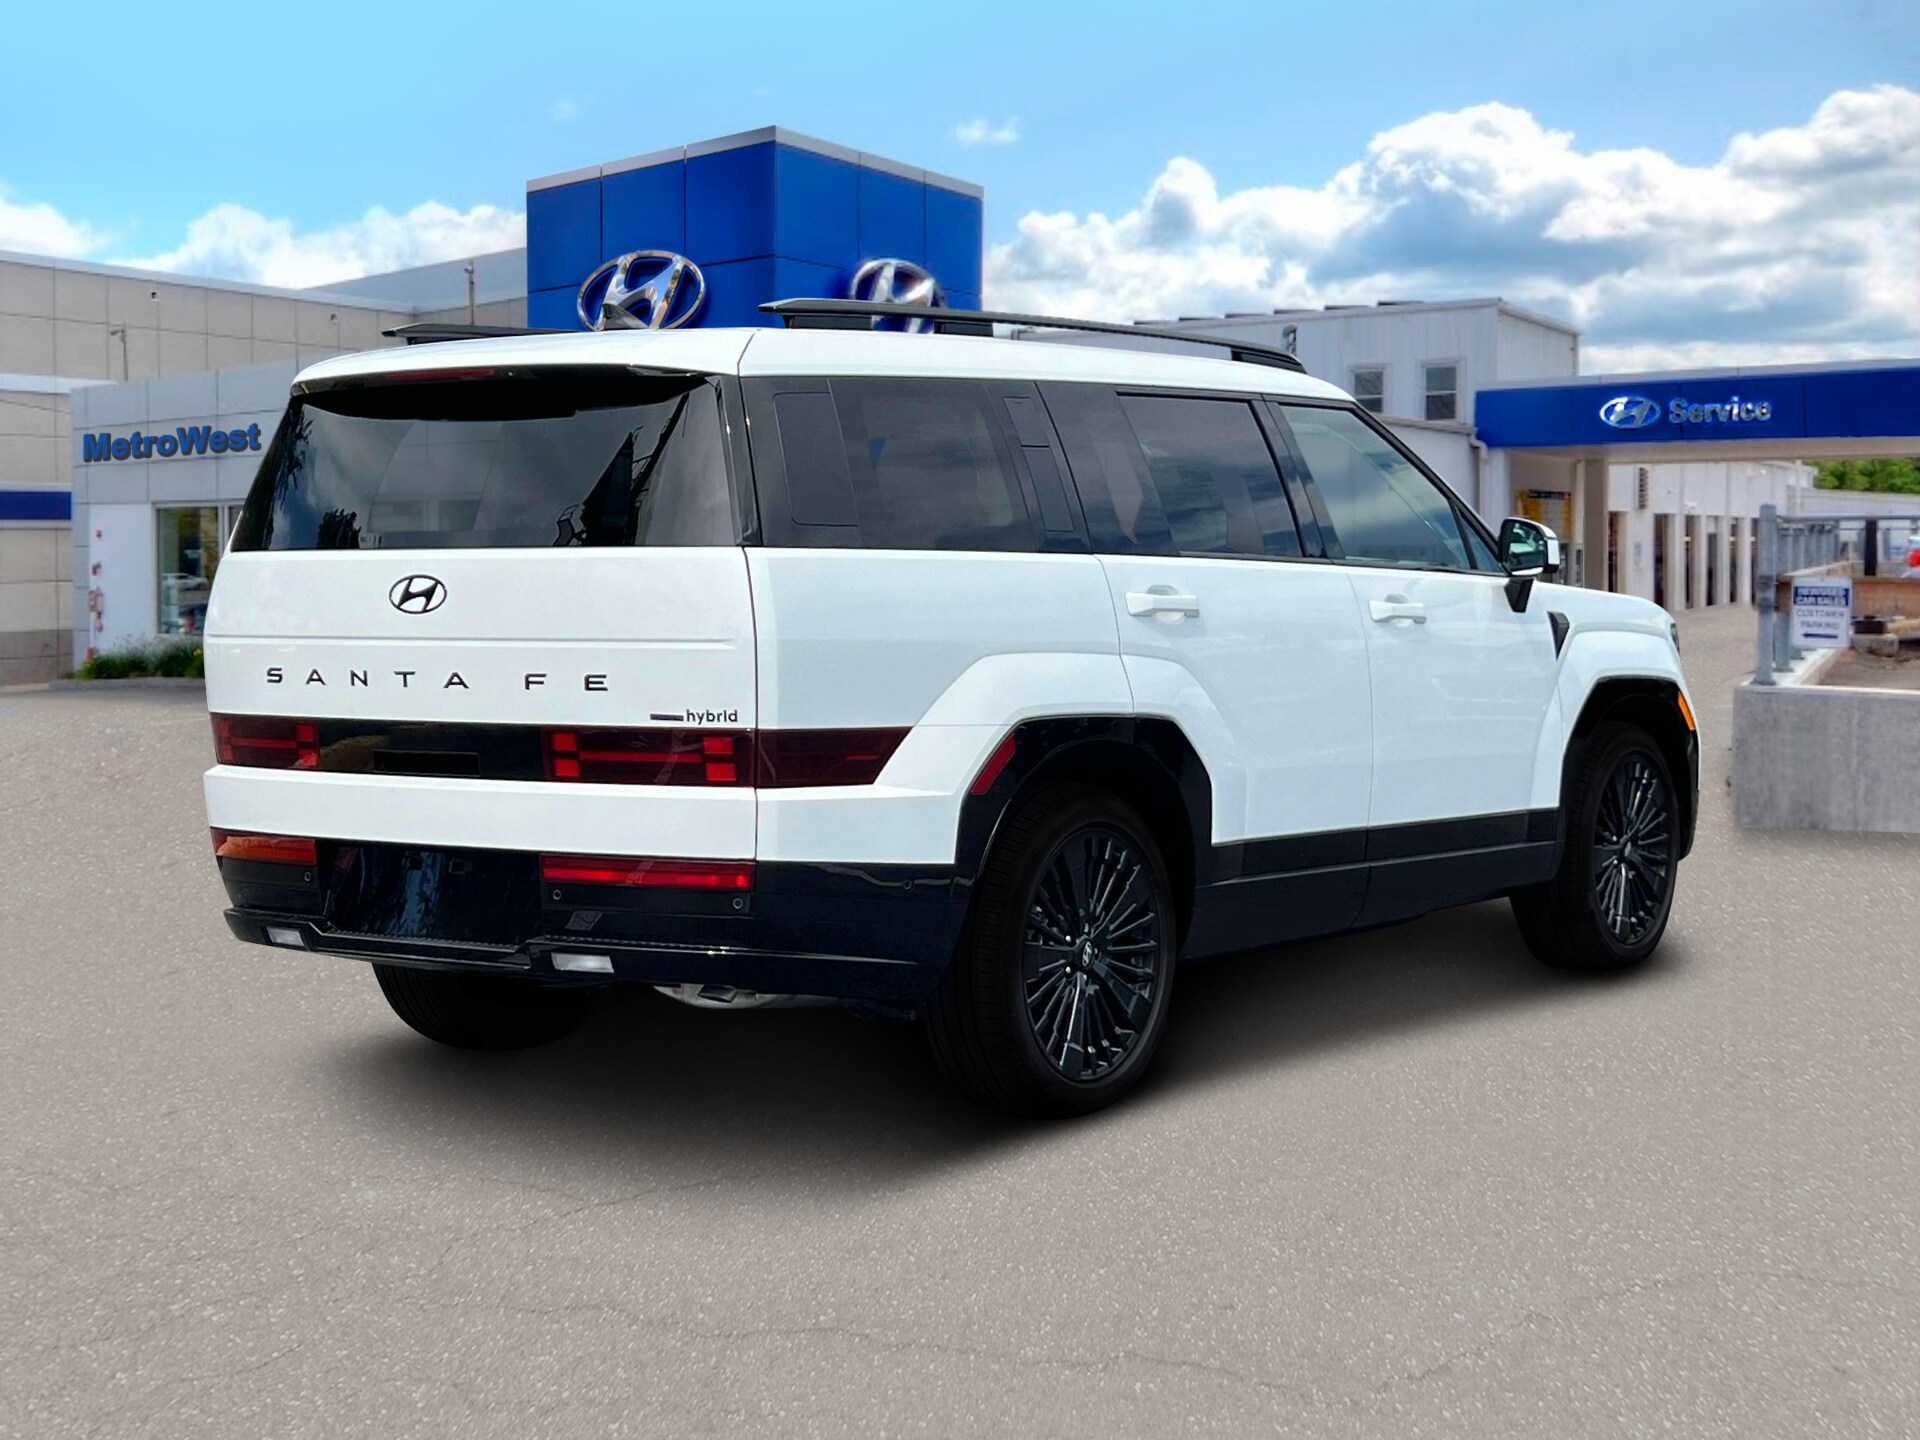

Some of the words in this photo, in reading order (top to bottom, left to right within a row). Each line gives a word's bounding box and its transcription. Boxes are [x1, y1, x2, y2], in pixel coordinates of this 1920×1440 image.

[1669, 396, 1771, 423] Service
[83, 423, 261, 462] MetroWest
[1796, 609, 1845, 618] CUSTOMER
[266, 667, 470, 690] SANTA
[524, 672, 609, 692] FE
[686, 709, 739, 725] hybrid
